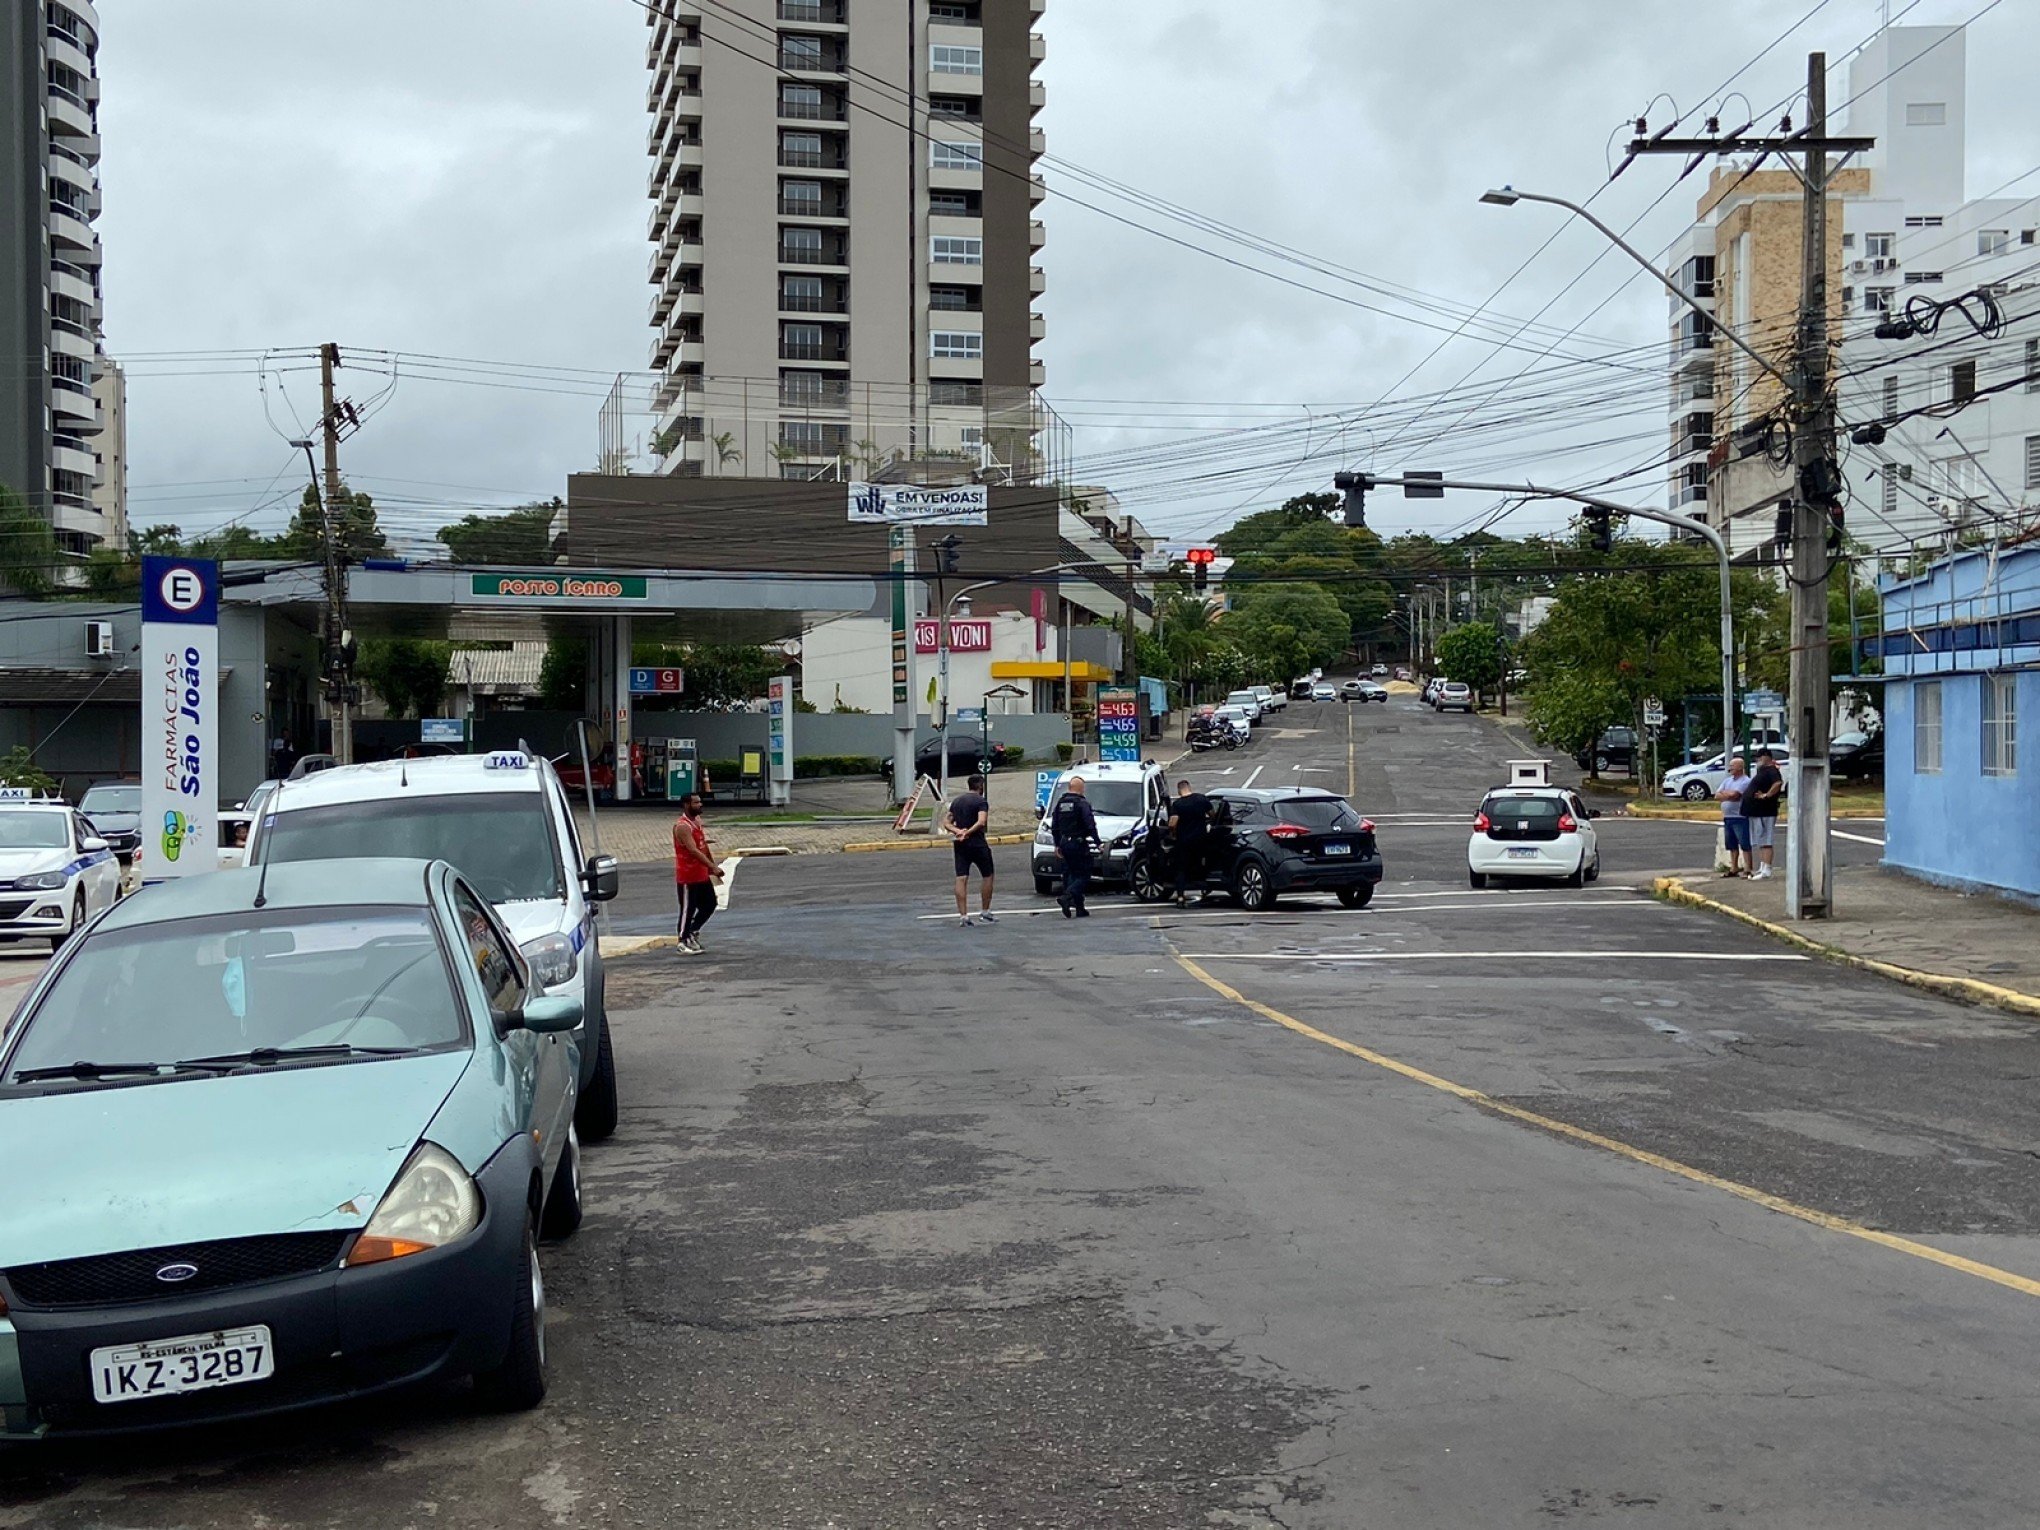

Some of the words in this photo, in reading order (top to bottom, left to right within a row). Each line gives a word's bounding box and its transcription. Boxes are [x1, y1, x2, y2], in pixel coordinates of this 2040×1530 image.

[896, 491, 918, 503] EM
[919, 491, 983, 504] VENDAS!
[171, 575, 191, 603] E
[499, 580, 559, 595] POSTO
[637, 671, 648, 682] D
[662, 671, 674, 682] G
[179, 646, 201, 725] João
[163, 651, 178, 792] FARMÁCIAS
[180, 734, 201, 798] São
[491, 756, 523, 766] TAXI
[0, 789, 24, 797] AXI
